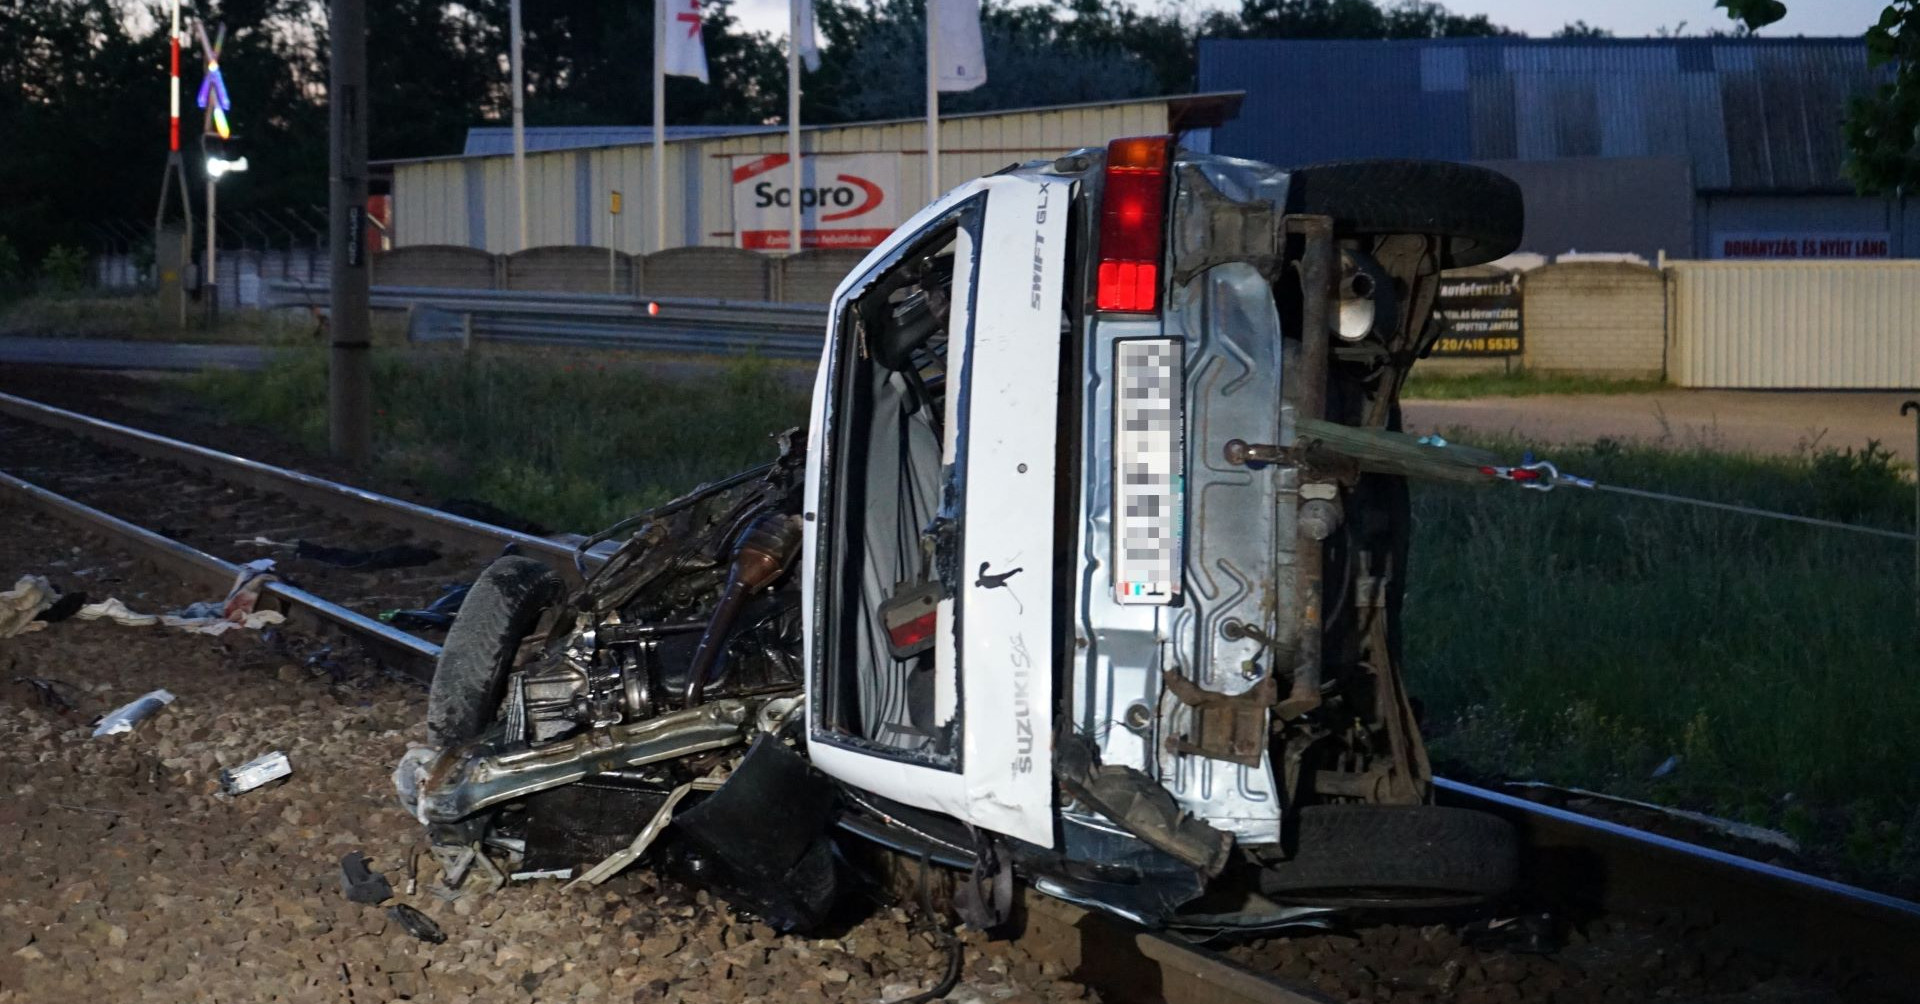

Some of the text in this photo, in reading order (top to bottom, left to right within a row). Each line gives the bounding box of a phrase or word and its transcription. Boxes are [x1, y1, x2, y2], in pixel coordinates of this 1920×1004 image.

[755, 182, 854, 214] Sopro
[1031, 182, 1050, 311] SWIFT GLX
[1014, 671, 1034, 774] SUZUKI
